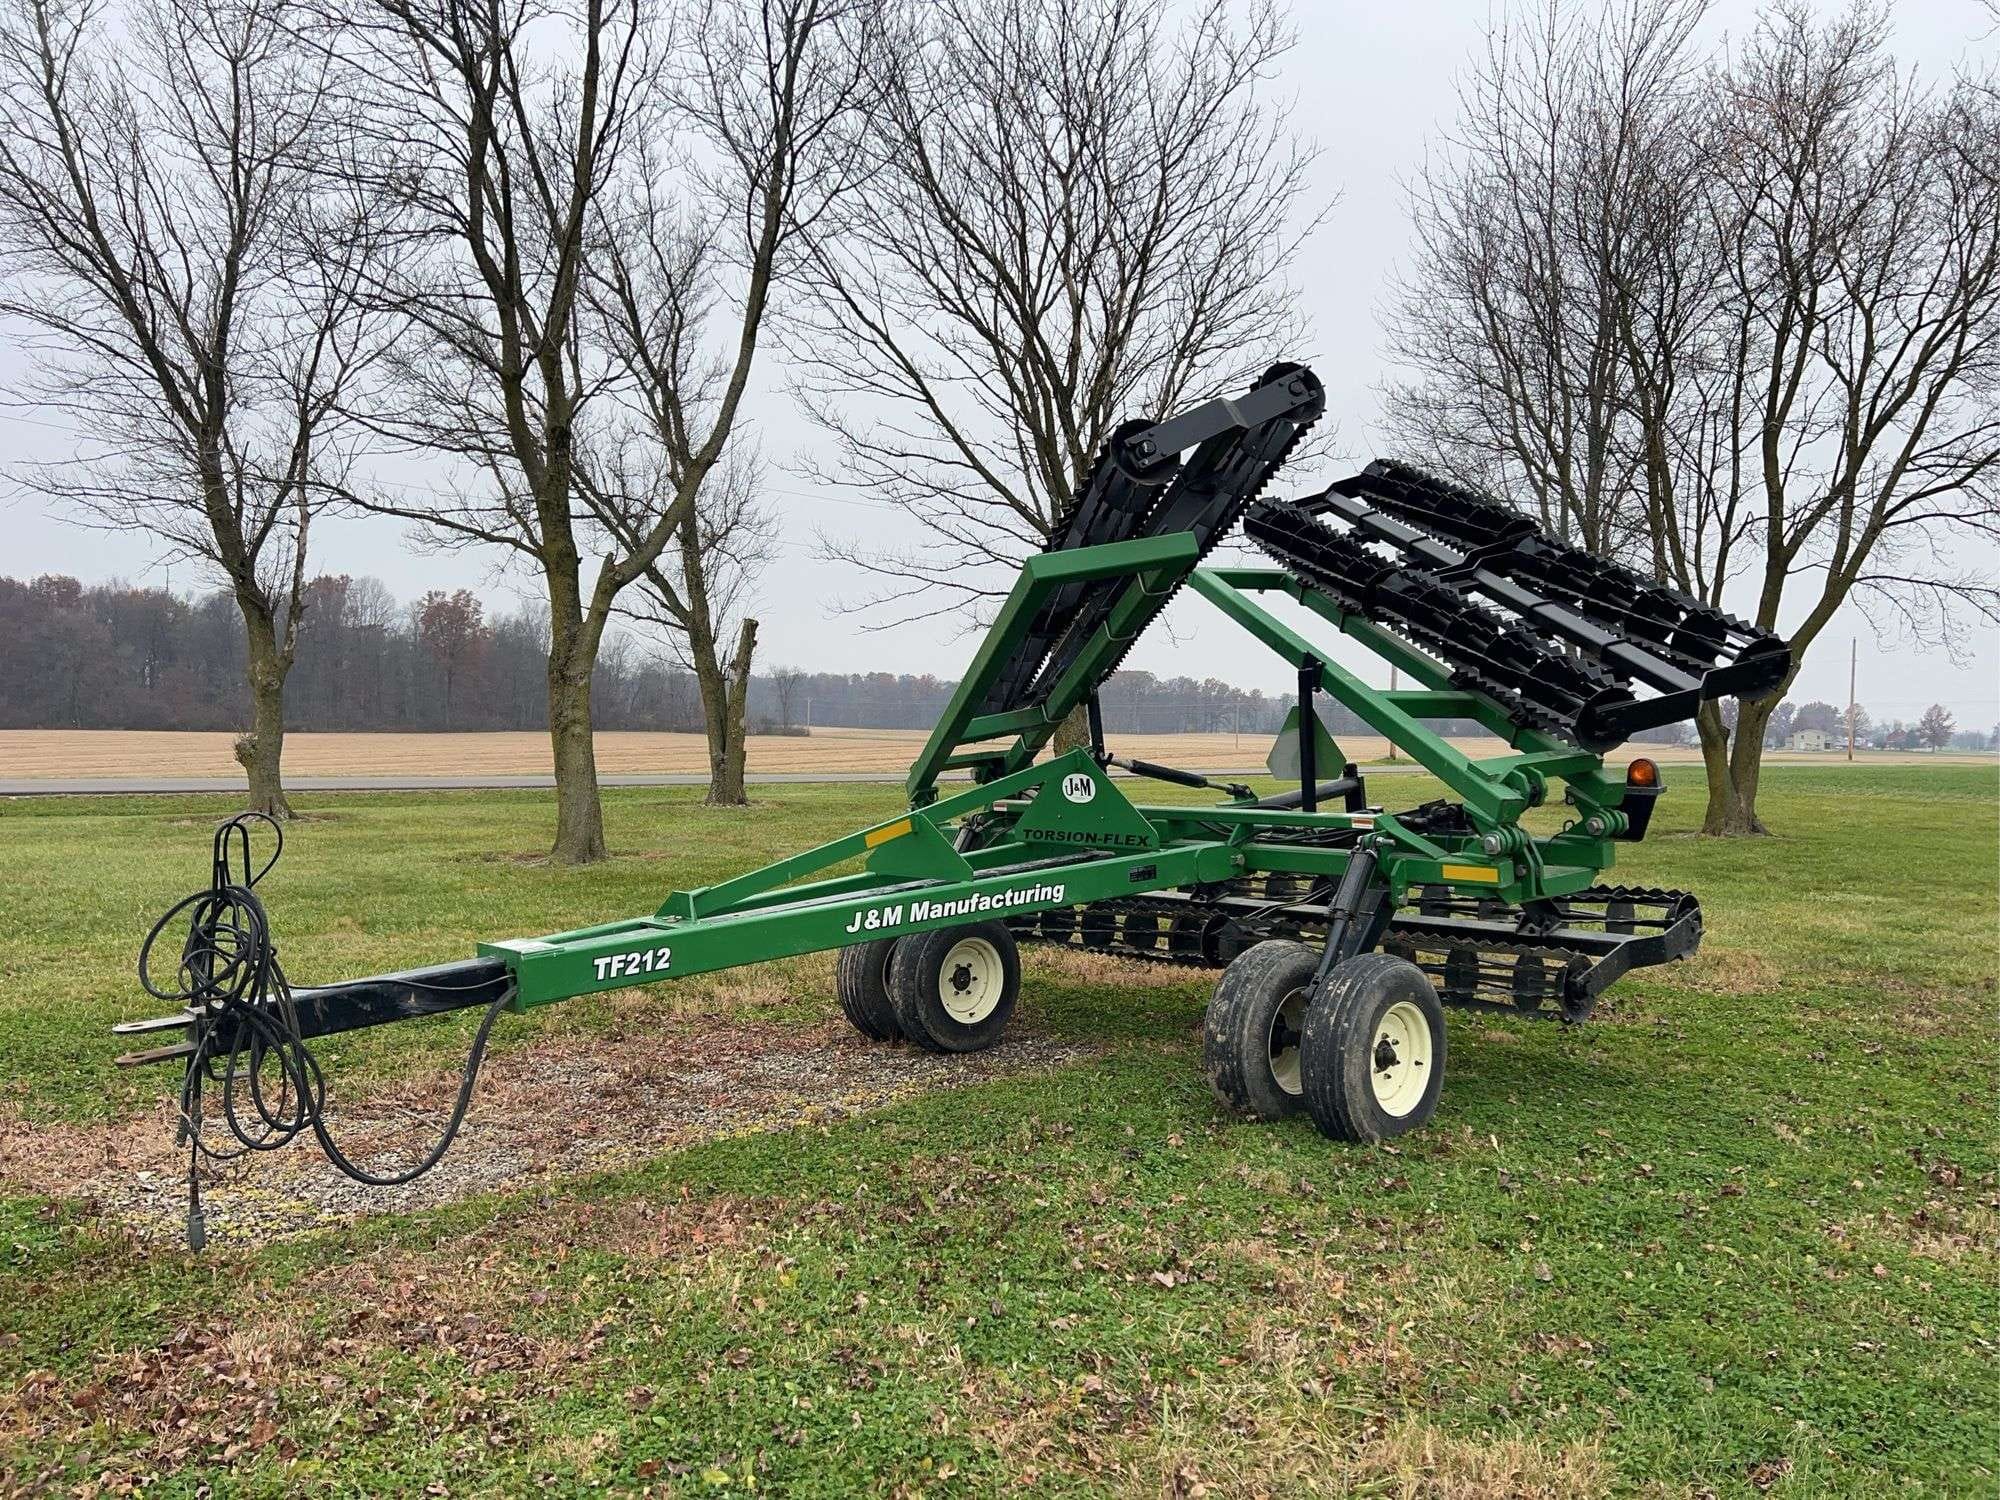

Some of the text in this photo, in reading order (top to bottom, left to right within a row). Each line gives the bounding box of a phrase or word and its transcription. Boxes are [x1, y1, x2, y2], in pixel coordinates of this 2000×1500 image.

[1065, 778, 1091, 796] J&M
[1023, 829, 1149, 847] TORSION-FLEX
[909, 883, 1065, 923] Manufacturing
[593, 947, 671, 980] TF212
